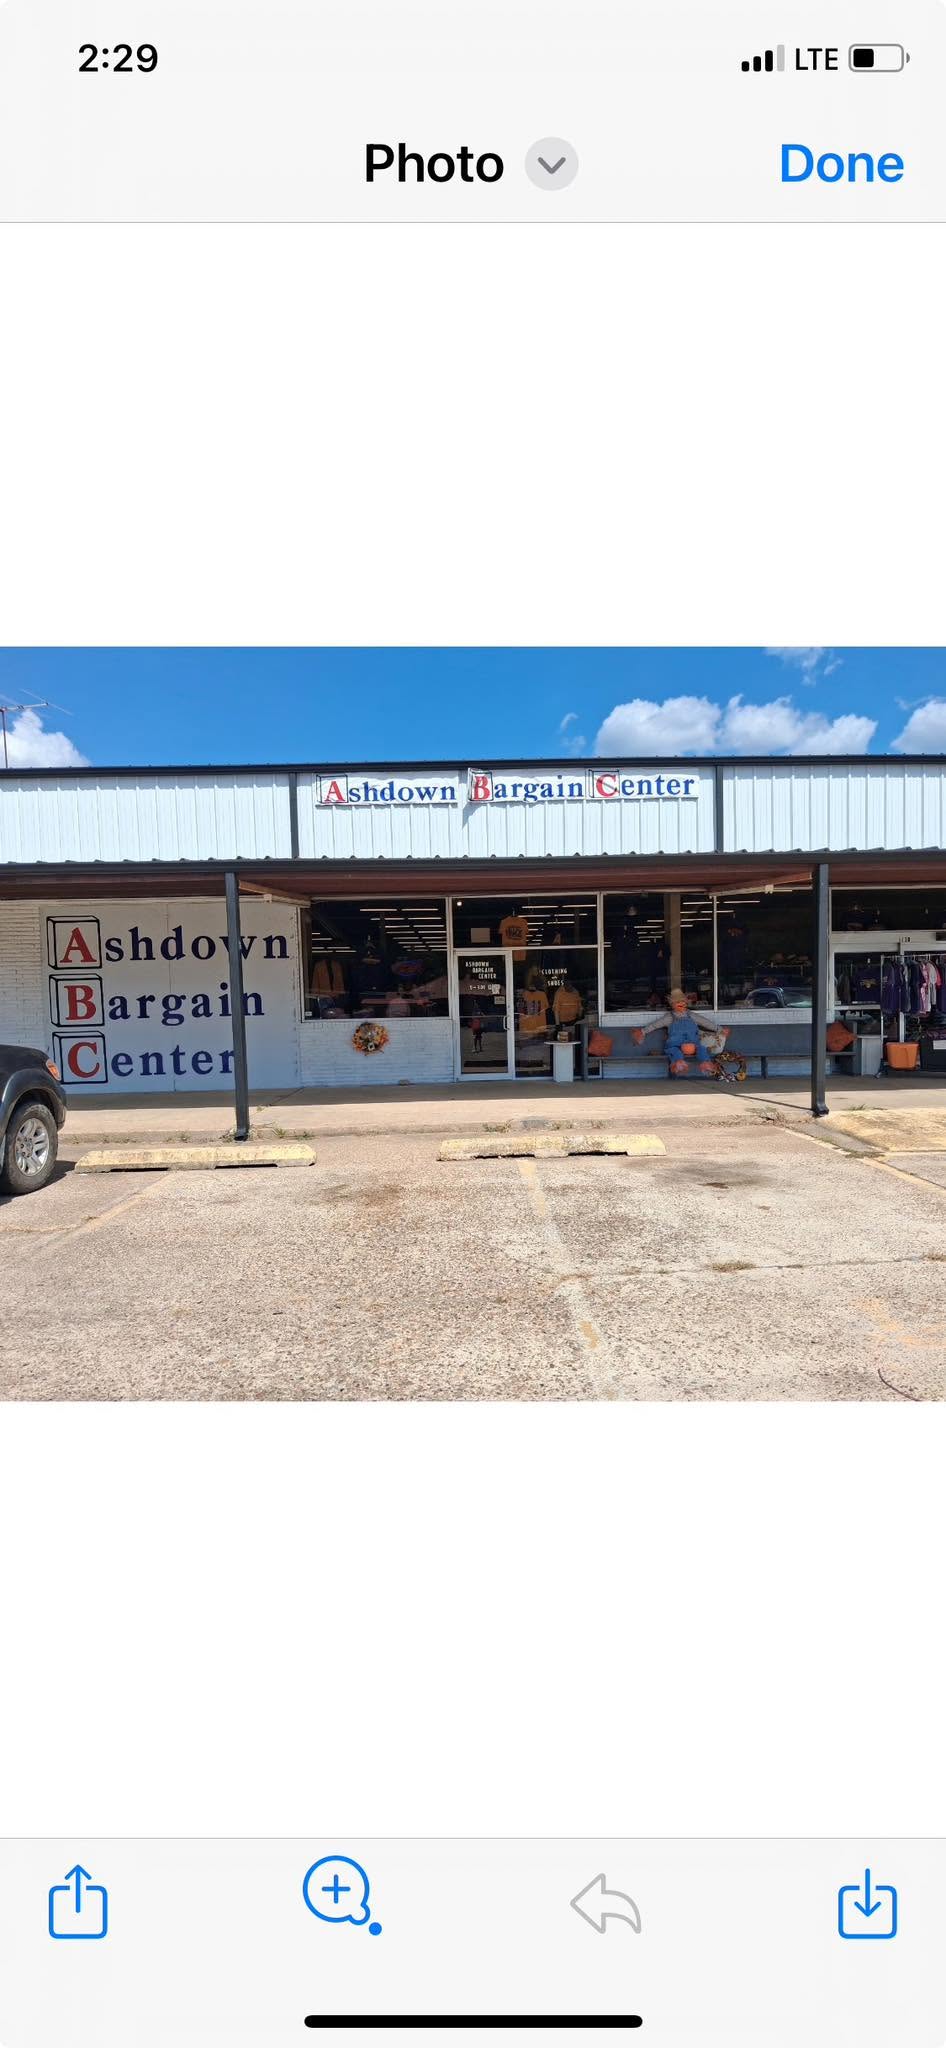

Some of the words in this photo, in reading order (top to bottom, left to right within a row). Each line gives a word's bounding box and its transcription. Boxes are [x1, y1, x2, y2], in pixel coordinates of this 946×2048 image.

[324, 780, 456, 803] Ashdown
[472, 775, 583, 802] Bargain
[596, 773, 695, 797] Center
[60, 925, 290, 963] Ashdown
[64, 982, 265, 1027] Bargain
[67, 1042, 236, 1079] Center
